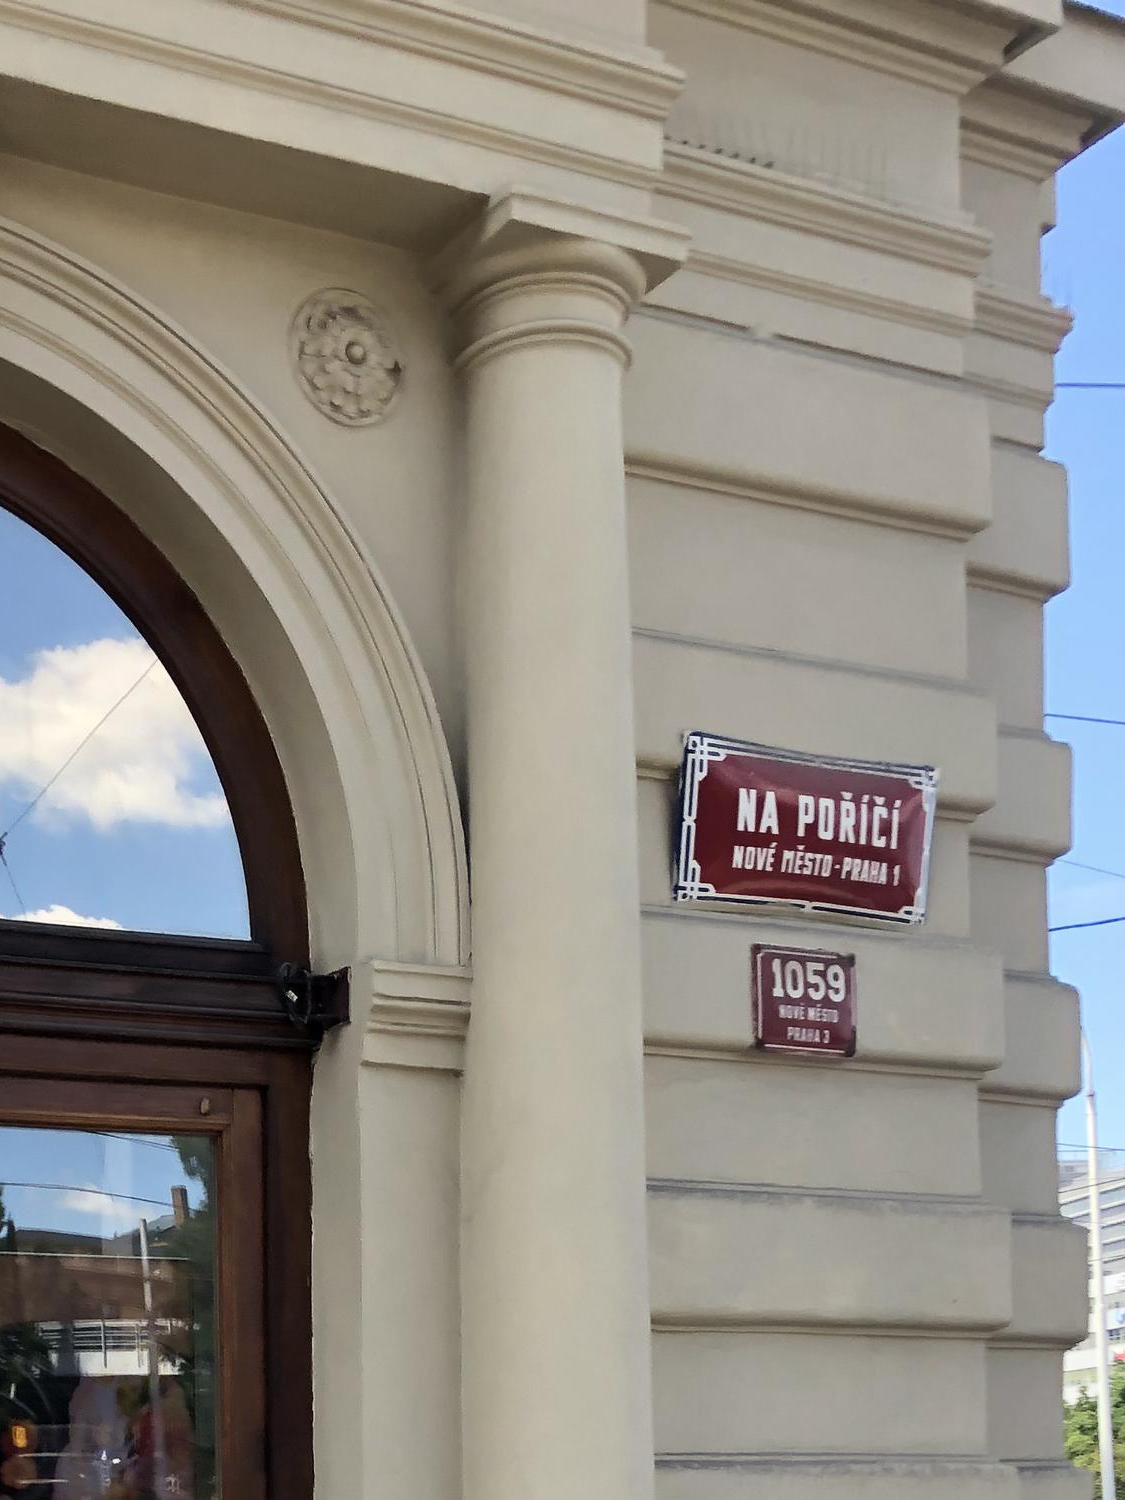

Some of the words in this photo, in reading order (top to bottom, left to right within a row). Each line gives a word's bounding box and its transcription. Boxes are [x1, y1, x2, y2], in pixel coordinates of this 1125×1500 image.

[737, 787, 779, 835] NA
[797, 791, 902, 849] POŘÍČÍ
[732, 842, 776, 872] NOVÉ
[892, 865, 900, 887] 1
[771, 957, 846, 1002] 1059
[787, 1026, 820, 1043] PRAHA
